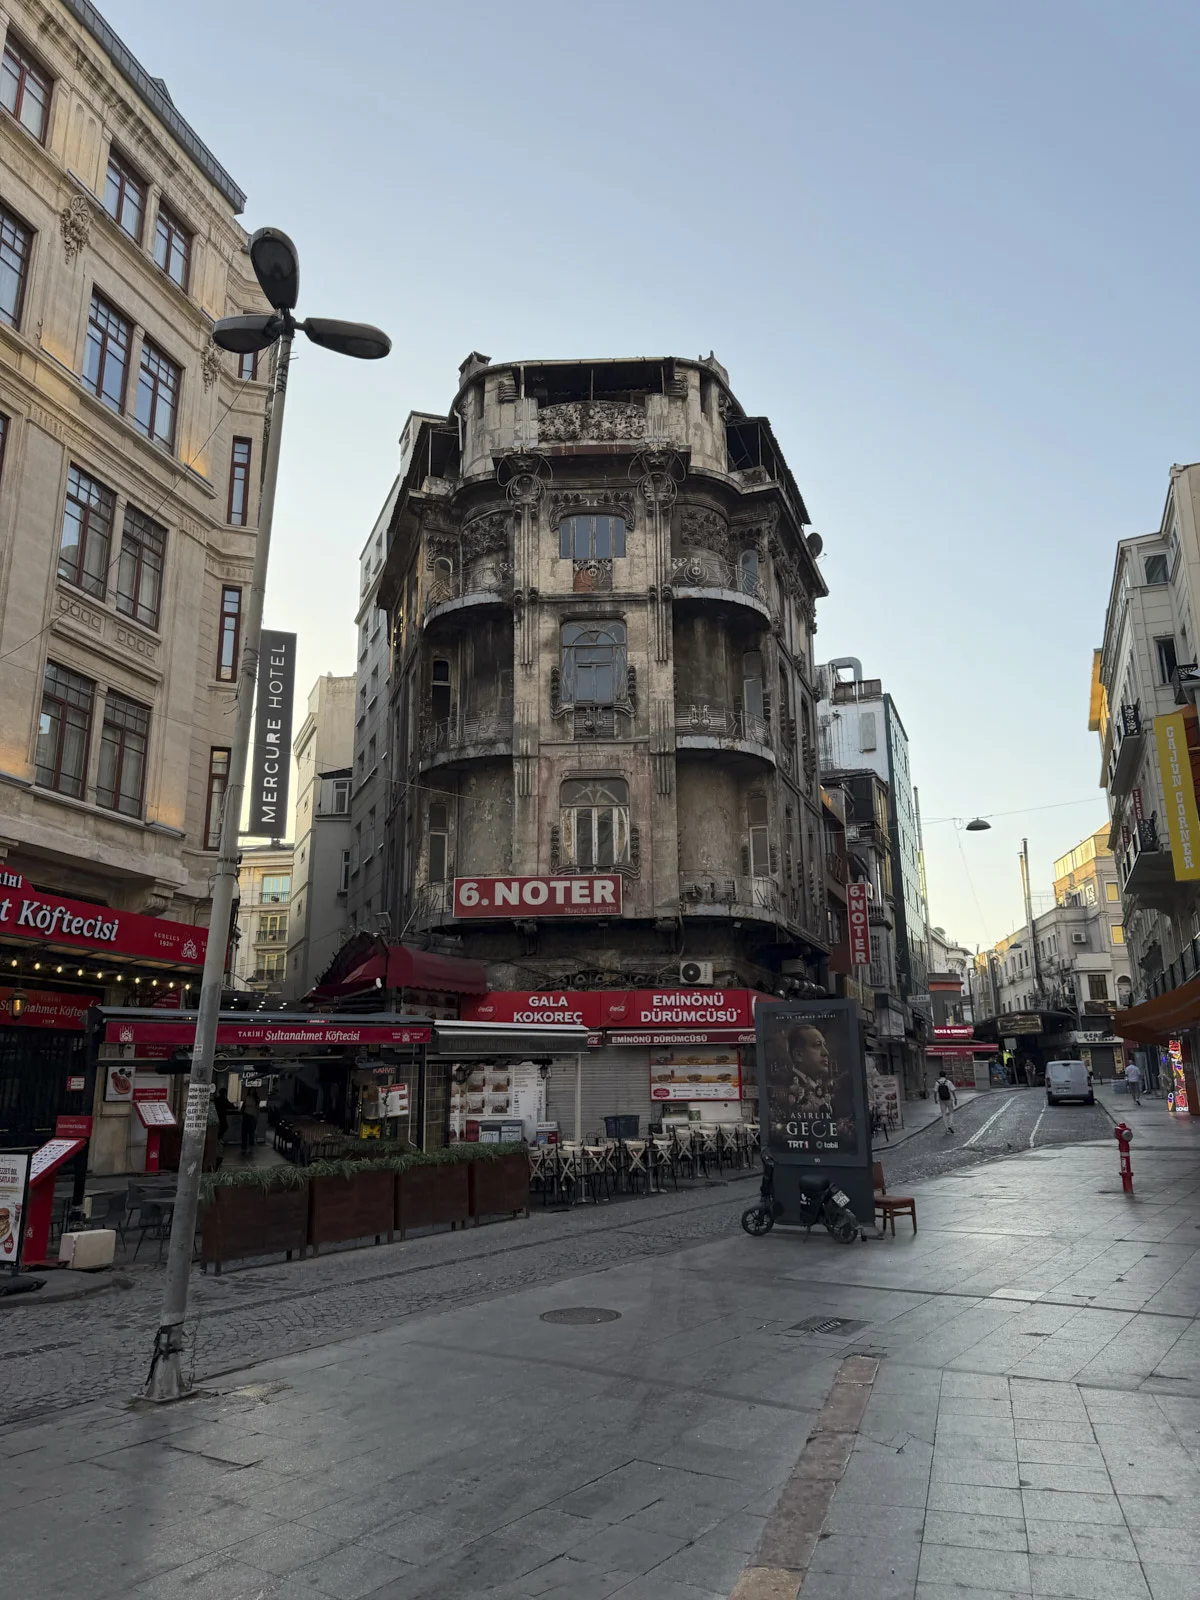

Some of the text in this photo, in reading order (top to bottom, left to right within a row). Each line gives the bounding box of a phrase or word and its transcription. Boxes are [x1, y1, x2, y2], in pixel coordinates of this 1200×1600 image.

[261, 644, 285, 823] MERCURE HOTEL
[1166, 726, 1194, 869] CAJUN CORNER
[17, 899, 119, 941] Köftecisi
[528, 996, 569, 1007] GALA
[653, 992, 725, 1006] EMİNÖNÜ
[513, 1011, 583, 1025] KOKOREÇ
[641, 1007, 738, 1023] DÜRÜMCÜSÜ
[265, 1031, 323, 1041] Sultanahmet
[325, 1031, 360, 1042] Köftecisi
[611, 1034, 708, 1043] EMİNÖNÜ DÜRÜMCÜSÜ
[786, 1120, 838, 1138] GECE
